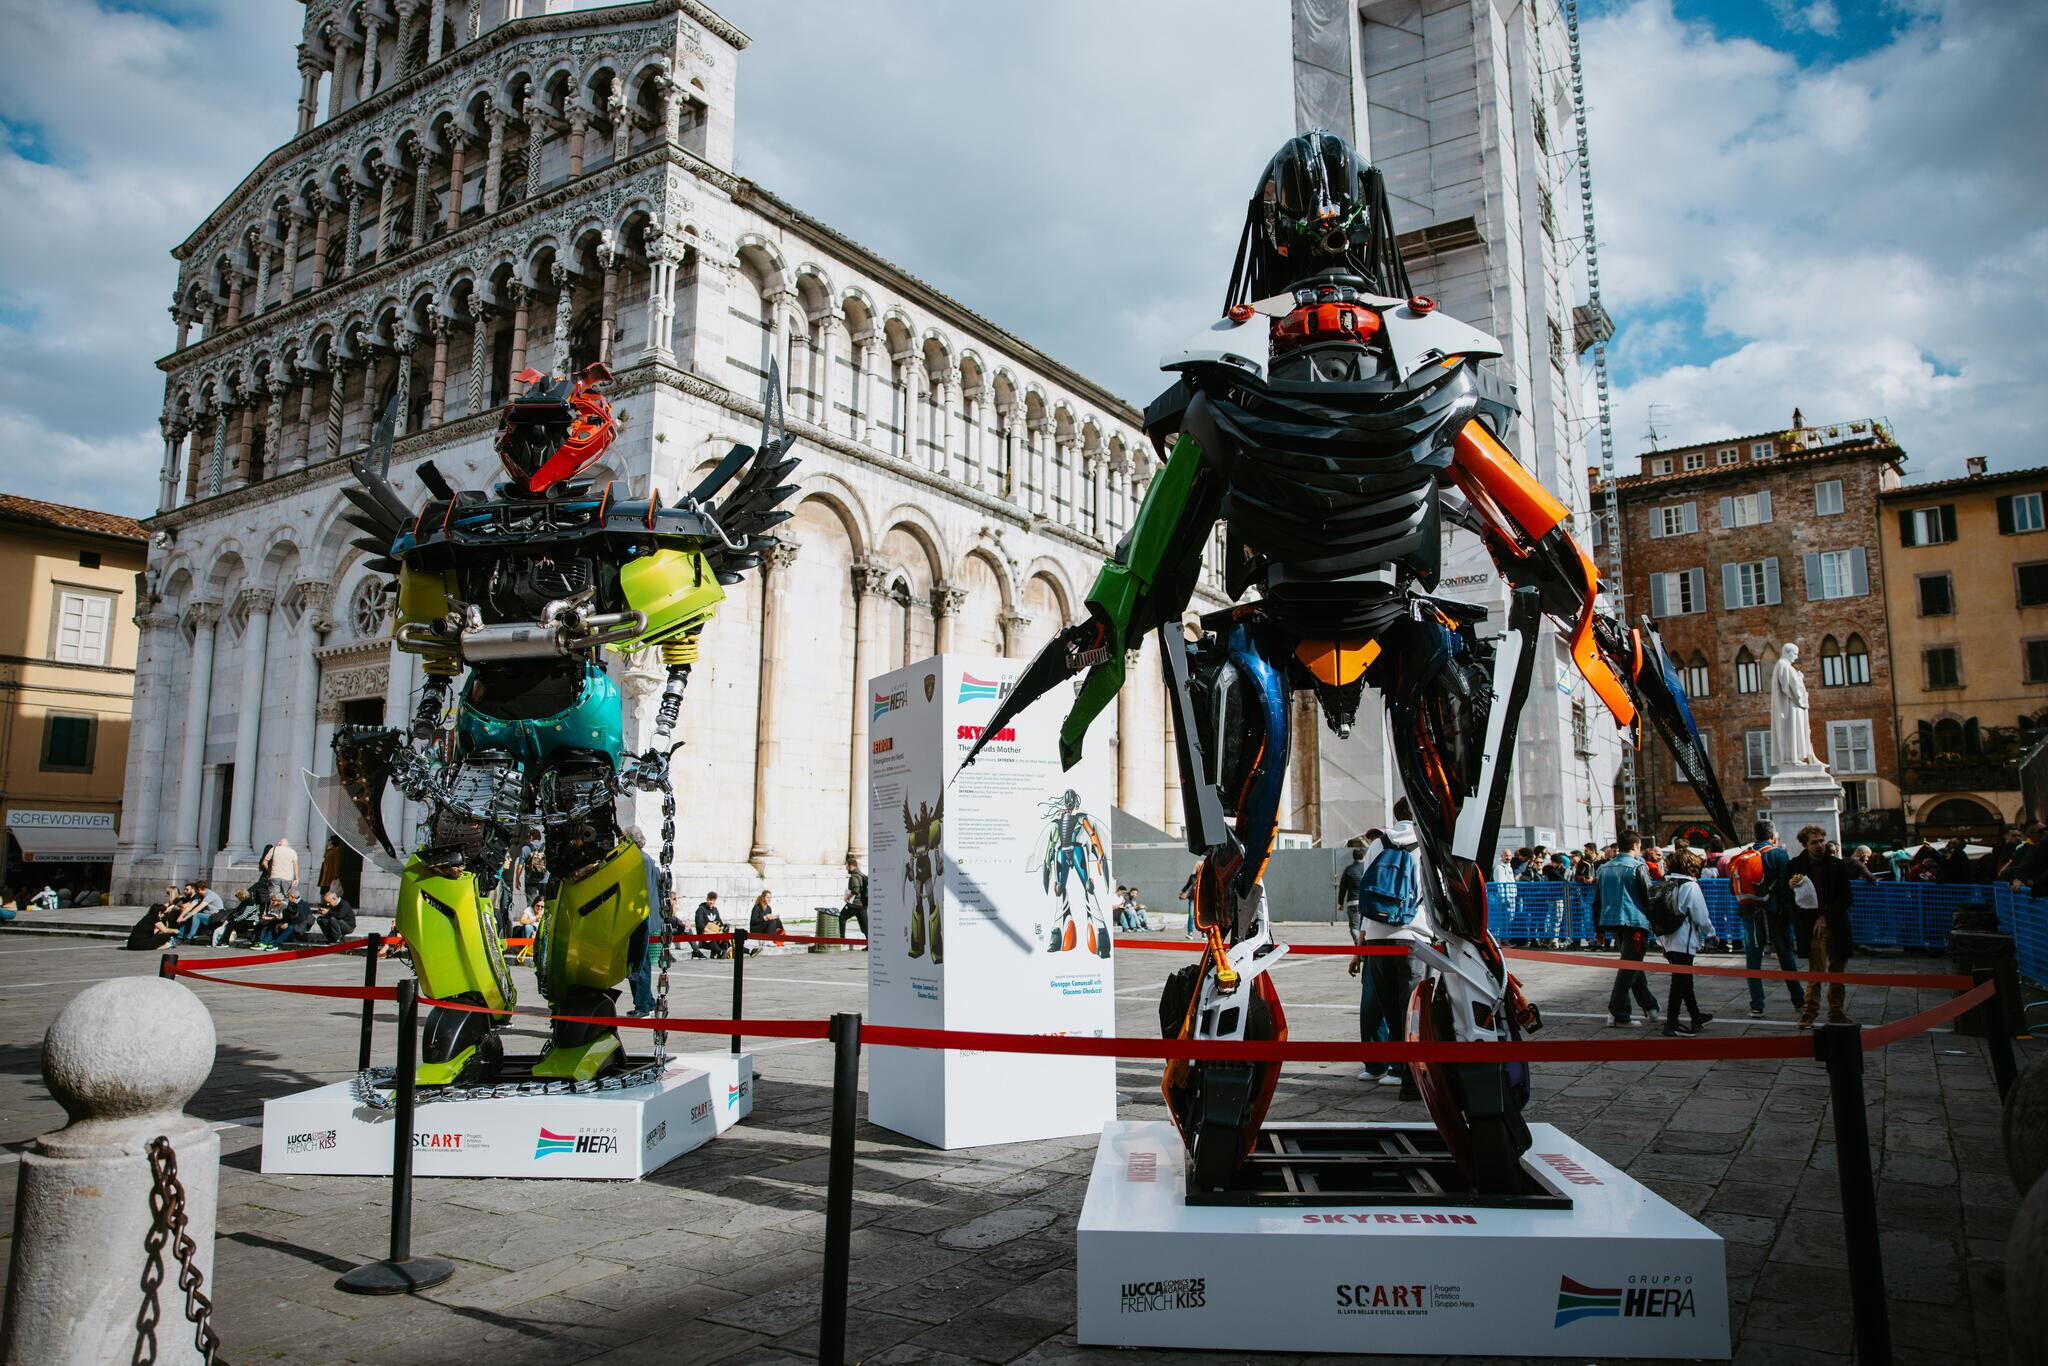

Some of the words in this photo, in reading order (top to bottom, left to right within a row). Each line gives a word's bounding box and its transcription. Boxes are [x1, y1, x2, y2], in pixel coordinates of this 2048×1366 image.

[889, 689, 908, 711] HERA
[997, 746, 1021, 754] Mother
[11, 812, 110, 826] SCREWDRIVER
[690, 1101, 708, 1121] SCART
[287, 1133, 312, 1144] LUCCA
[327, 1130, 336, 1139] 25
[412, 1133, 463, 1148] SCART
[575, 1135, 618, 1153] HERA
[287, 1140, 318, 1154] FRENCH
[320, 1138, 336, 1149] KISS
[1302, 1214, 1478, 1225] SKYRENN
[1163, 1279, 1189, 1288] COMICS
[1628, 1275, 1693, 1285] GRUPPO
[1122, 1282, 1164, 1298] LUCCA
[1189, 1278, 1206, 1293] 25
[1434, 1285, 1461, 1293] Progetto
[1121, 1294, 1173, 1314] FRENCH
[1176, 1291, 1206, 1309] KISS
[1336, 1284, 1426, 1308] SCART
[1623, 1288, 1696, 1318] HERA
